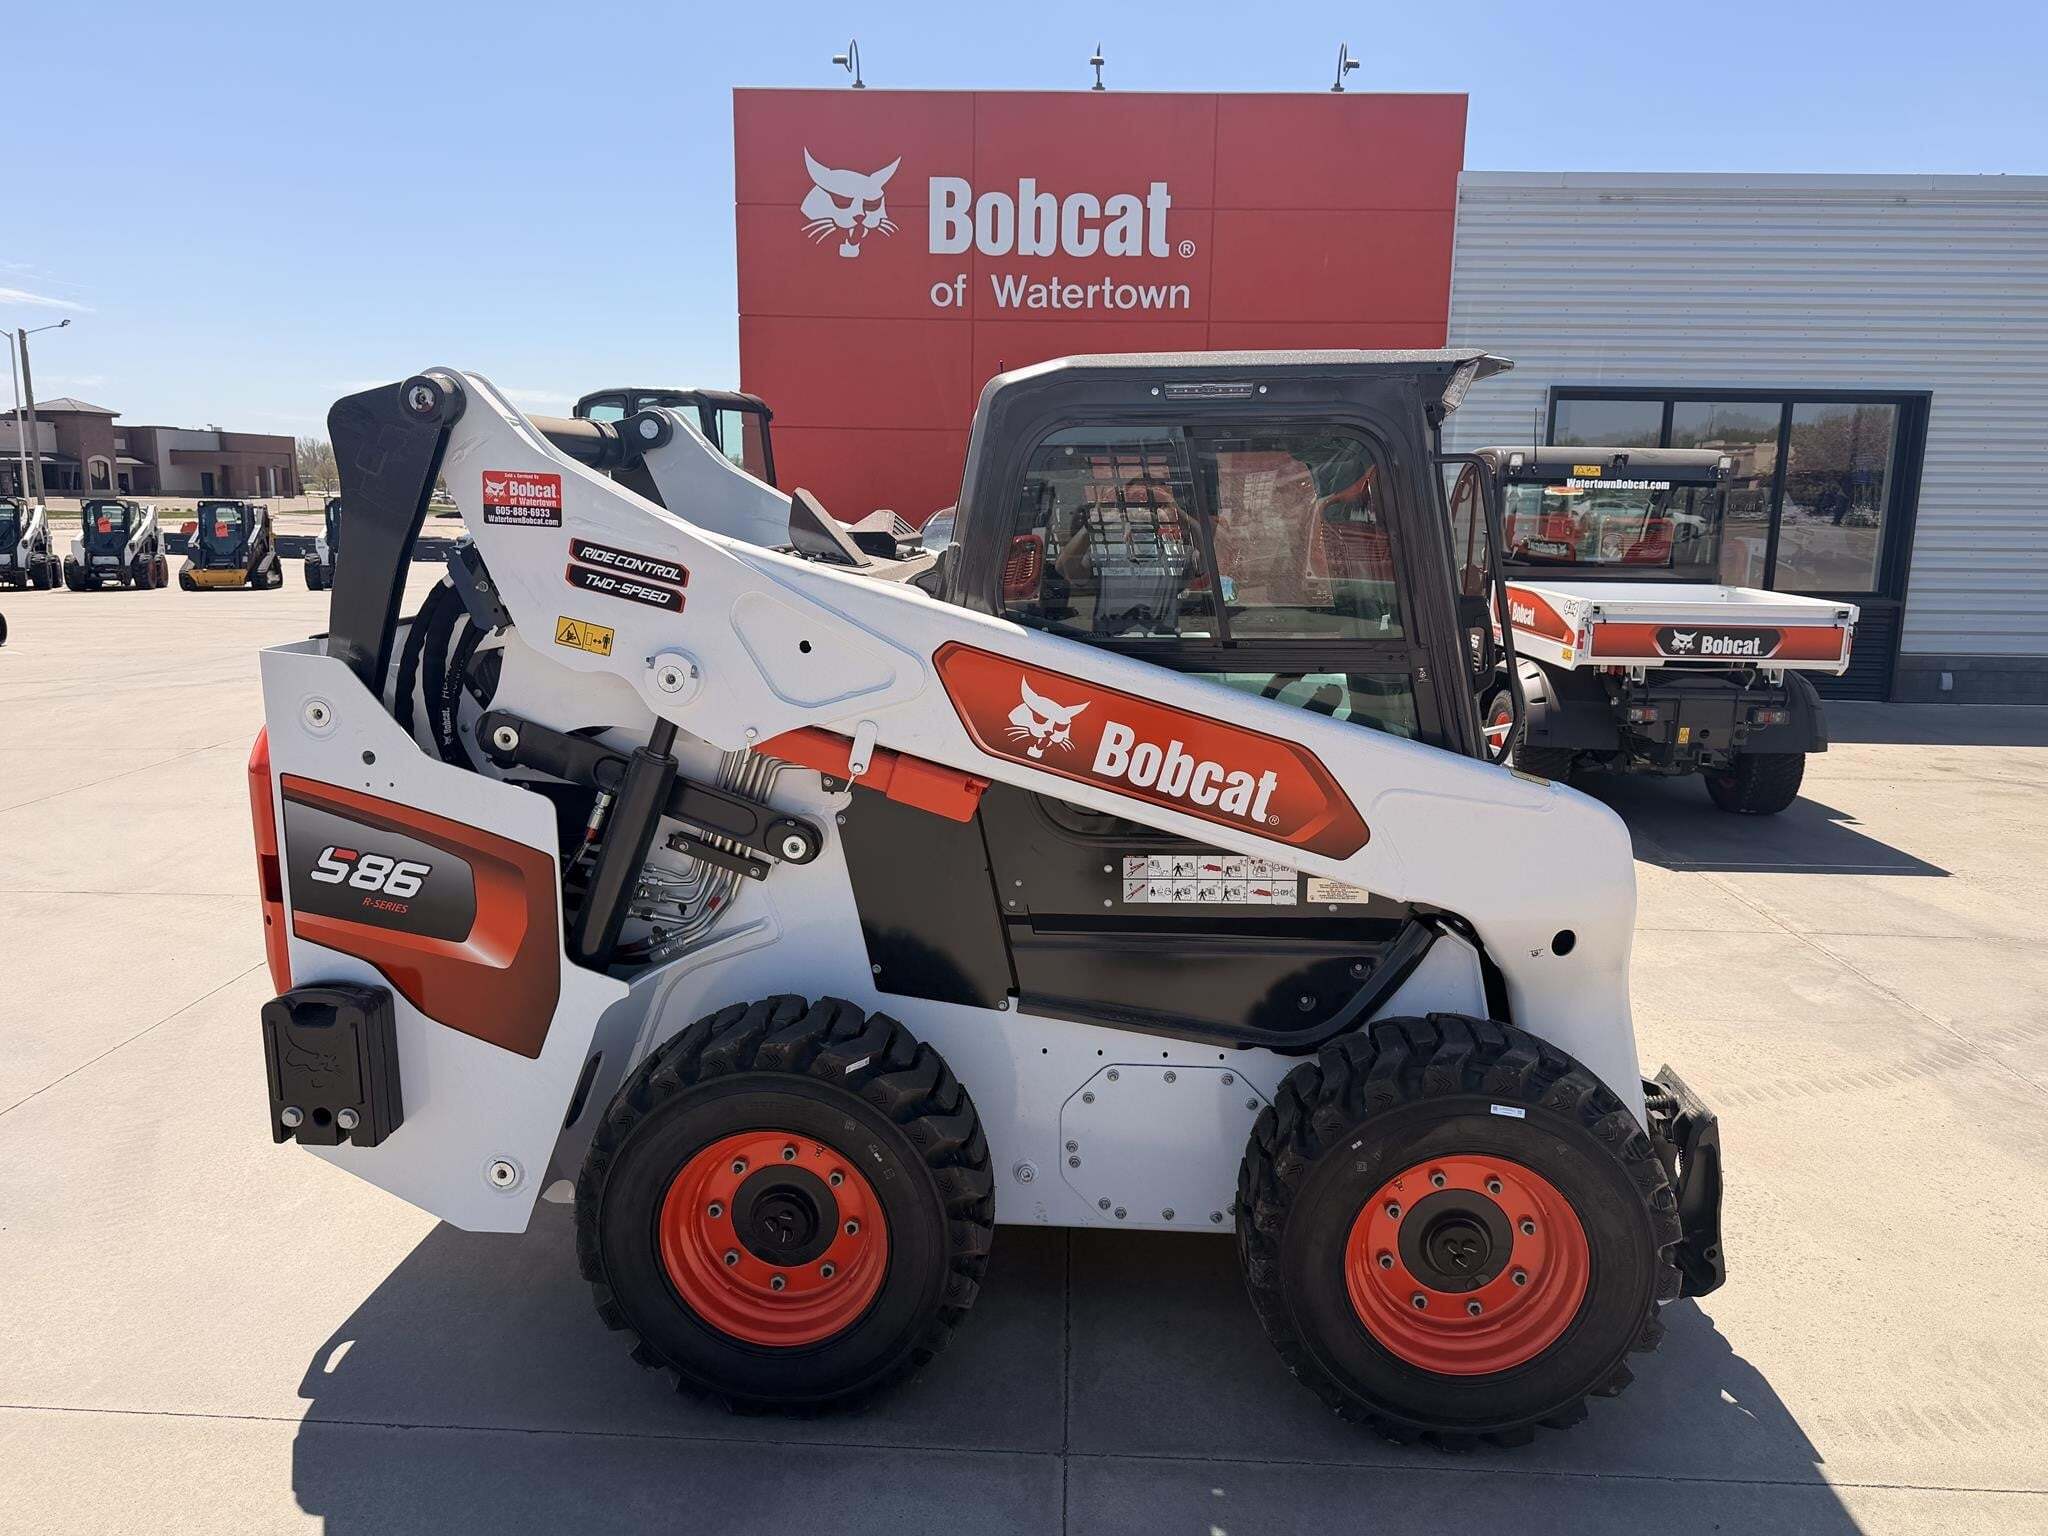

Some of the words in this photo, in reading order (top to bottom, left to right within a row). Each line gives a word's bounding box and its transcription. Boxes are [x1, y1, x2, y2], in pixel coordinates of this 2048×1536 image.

[931, 274, 967, 308] of
[991, 274, 1191, 310] Watertown
[509, 481, 557, 498] Bobcat
[1566, 478, 1670, 490] WatertownBobcat.com
[510, 497, 517, 505] of
[518, 498, 557, 507] Watertown
[487, 514, 559, 527] WatertownBobcat.com
[580, 547, 616, 564] RIDE
[614, 554, 681, 581] CONTROL
[585, 573, 671, 604] TWO-SPEED
[1512, 602, 1536, 626] Bobcat
[1700, 635, 1761, 655] Bobcat
[310, 846, 431, 898] S86
[362, 896, 409, 914] R-SERIES
